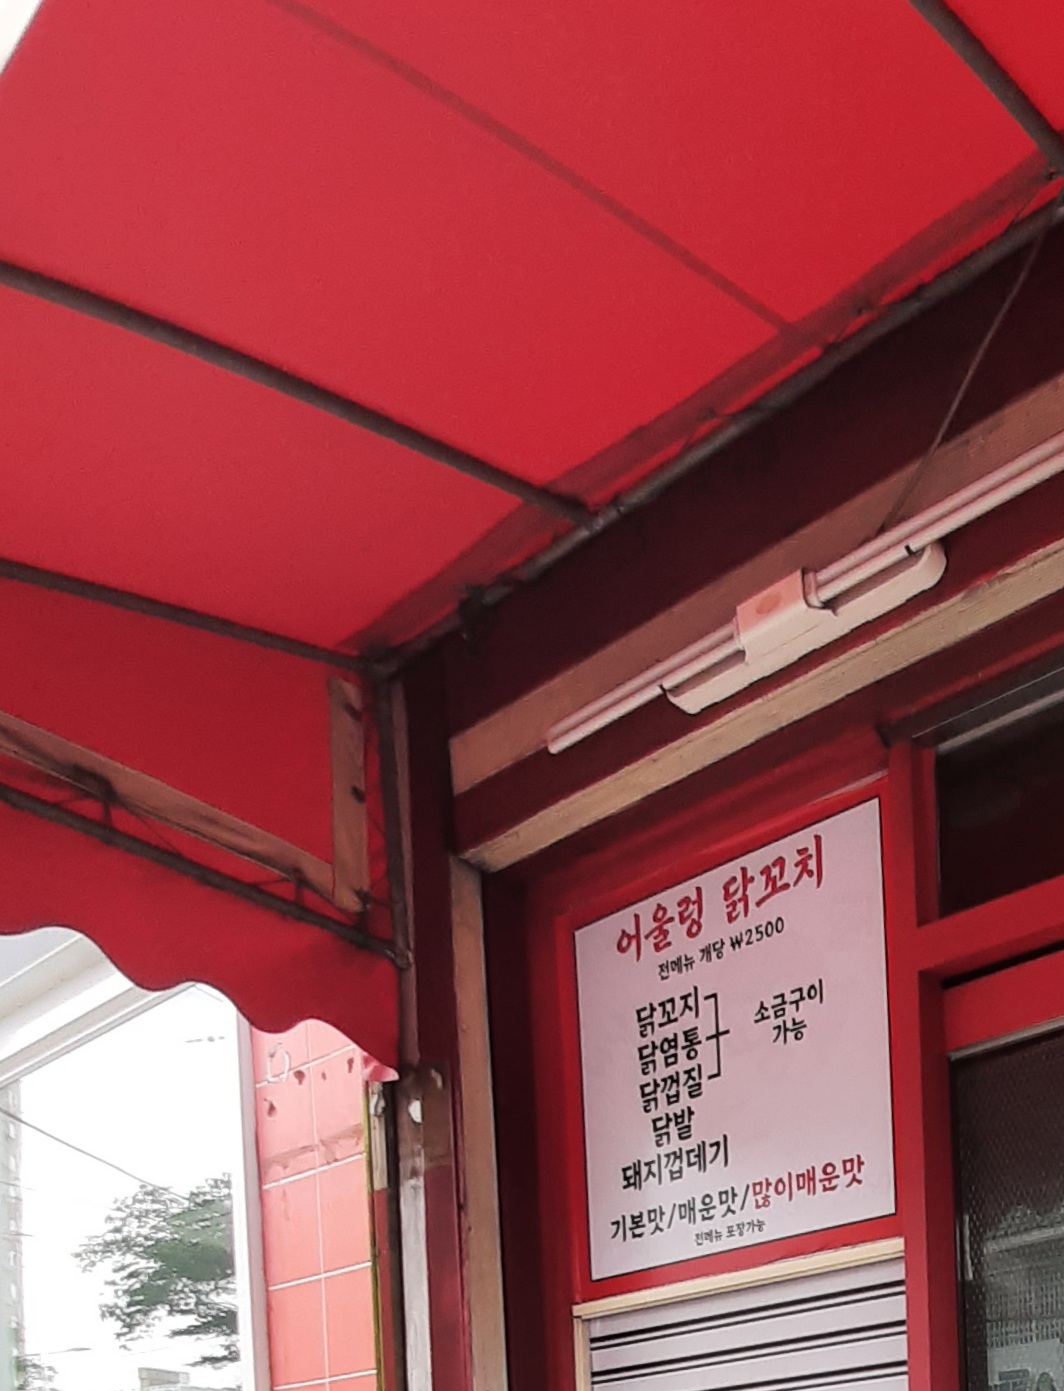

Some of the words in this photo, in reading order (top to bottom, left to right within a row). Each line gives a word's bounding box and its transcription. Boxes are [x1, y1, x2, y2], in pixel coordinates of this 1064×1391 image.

[616, 886, 703, 962] 어울렁
[722, 834, 823, 924] 닭꼬치
[657, 954, 696, 981] 전메뉴
[698, 938, 725, 963] 개당
[635, 985, 700, 1038] 닭꼬지
[754, 978, 823, 1024] 소금구이
[637, 1026, 702, 1076] 닭염통
[772, 1017, 807, 1045] 가능
[639, 1063, 703, 1114] 닭껍질
[652, 1105, 695, 1148] 닭발
[621, 1134, 729, 1191] 돼지껍데기
[726, 1219, 766, 1238] 포장가능
